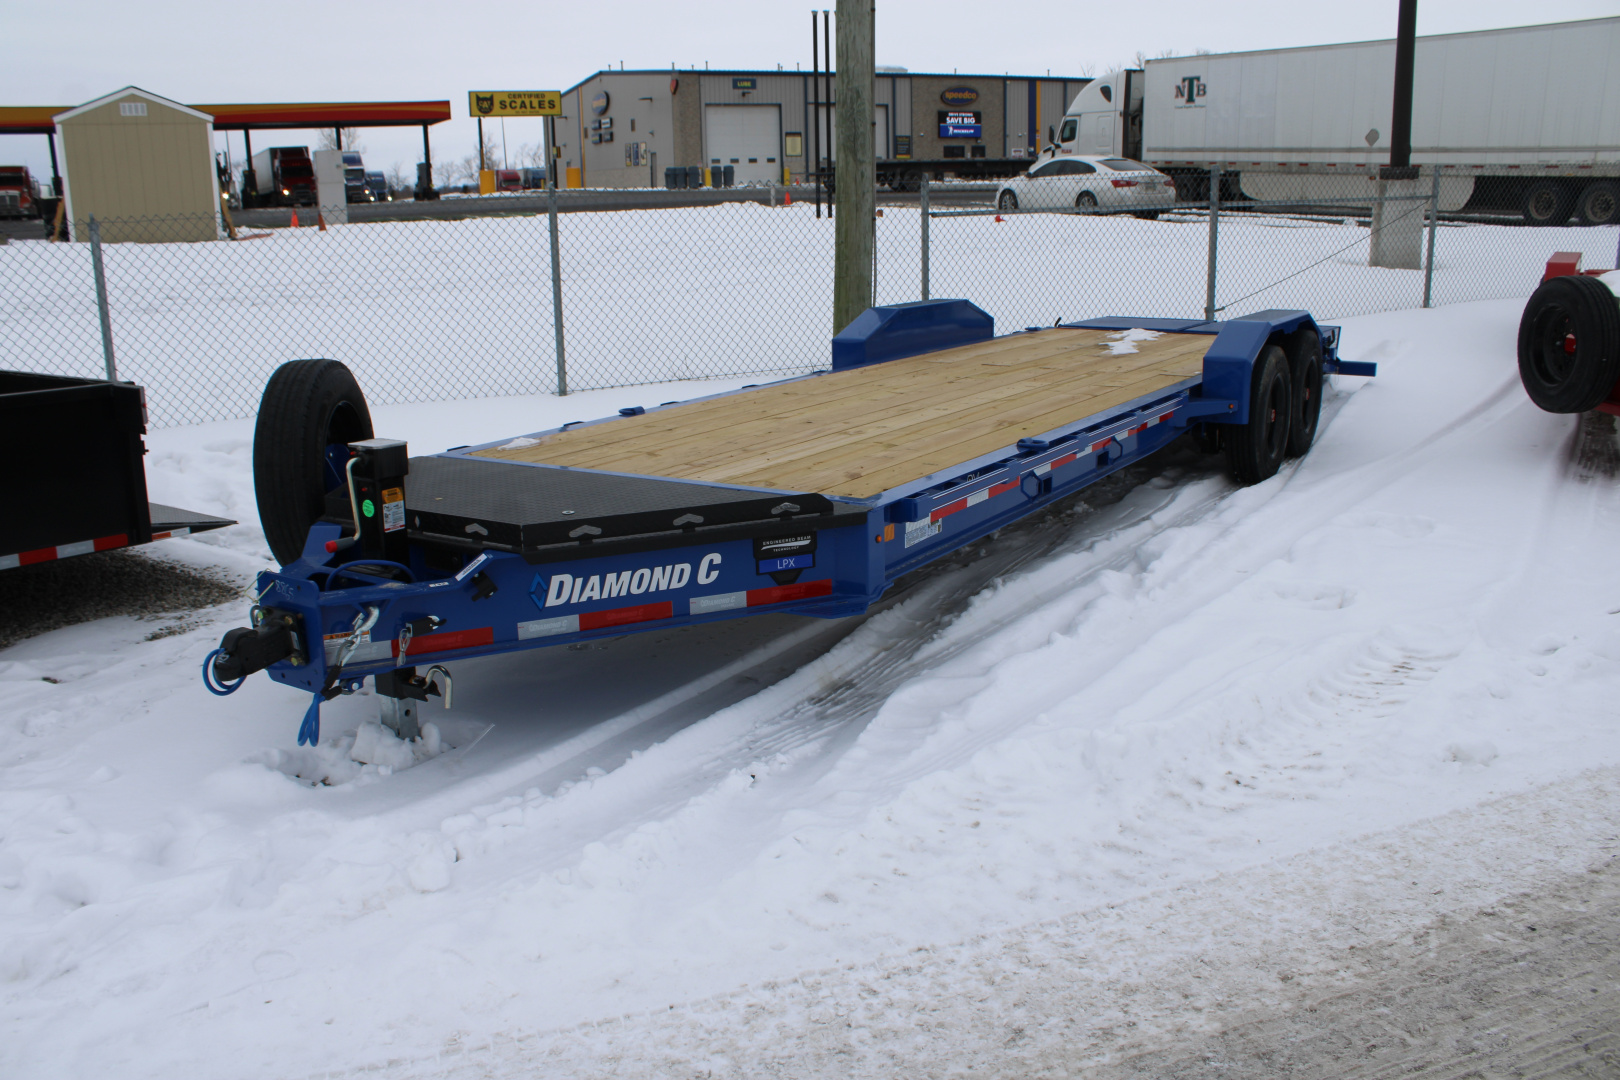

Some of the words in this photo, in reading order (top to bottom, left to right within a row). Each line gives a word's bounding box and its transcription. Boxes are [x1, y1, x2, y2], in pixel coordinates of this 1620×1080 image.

[945, 90, 977, 100] speedco
[1175, 76, 1207, 104] NTB
[499, 100, 556, 110] SCALES
[946, 116, 962, 124] SAVE
[963, 116, 976, 124] BIG
[762, 537, 796, 546] ENGINEERED
[777, 558, 796, 569] LPX
[545, 563, 692, 608] DIAMOND
[697, 552, 722, 585] C
